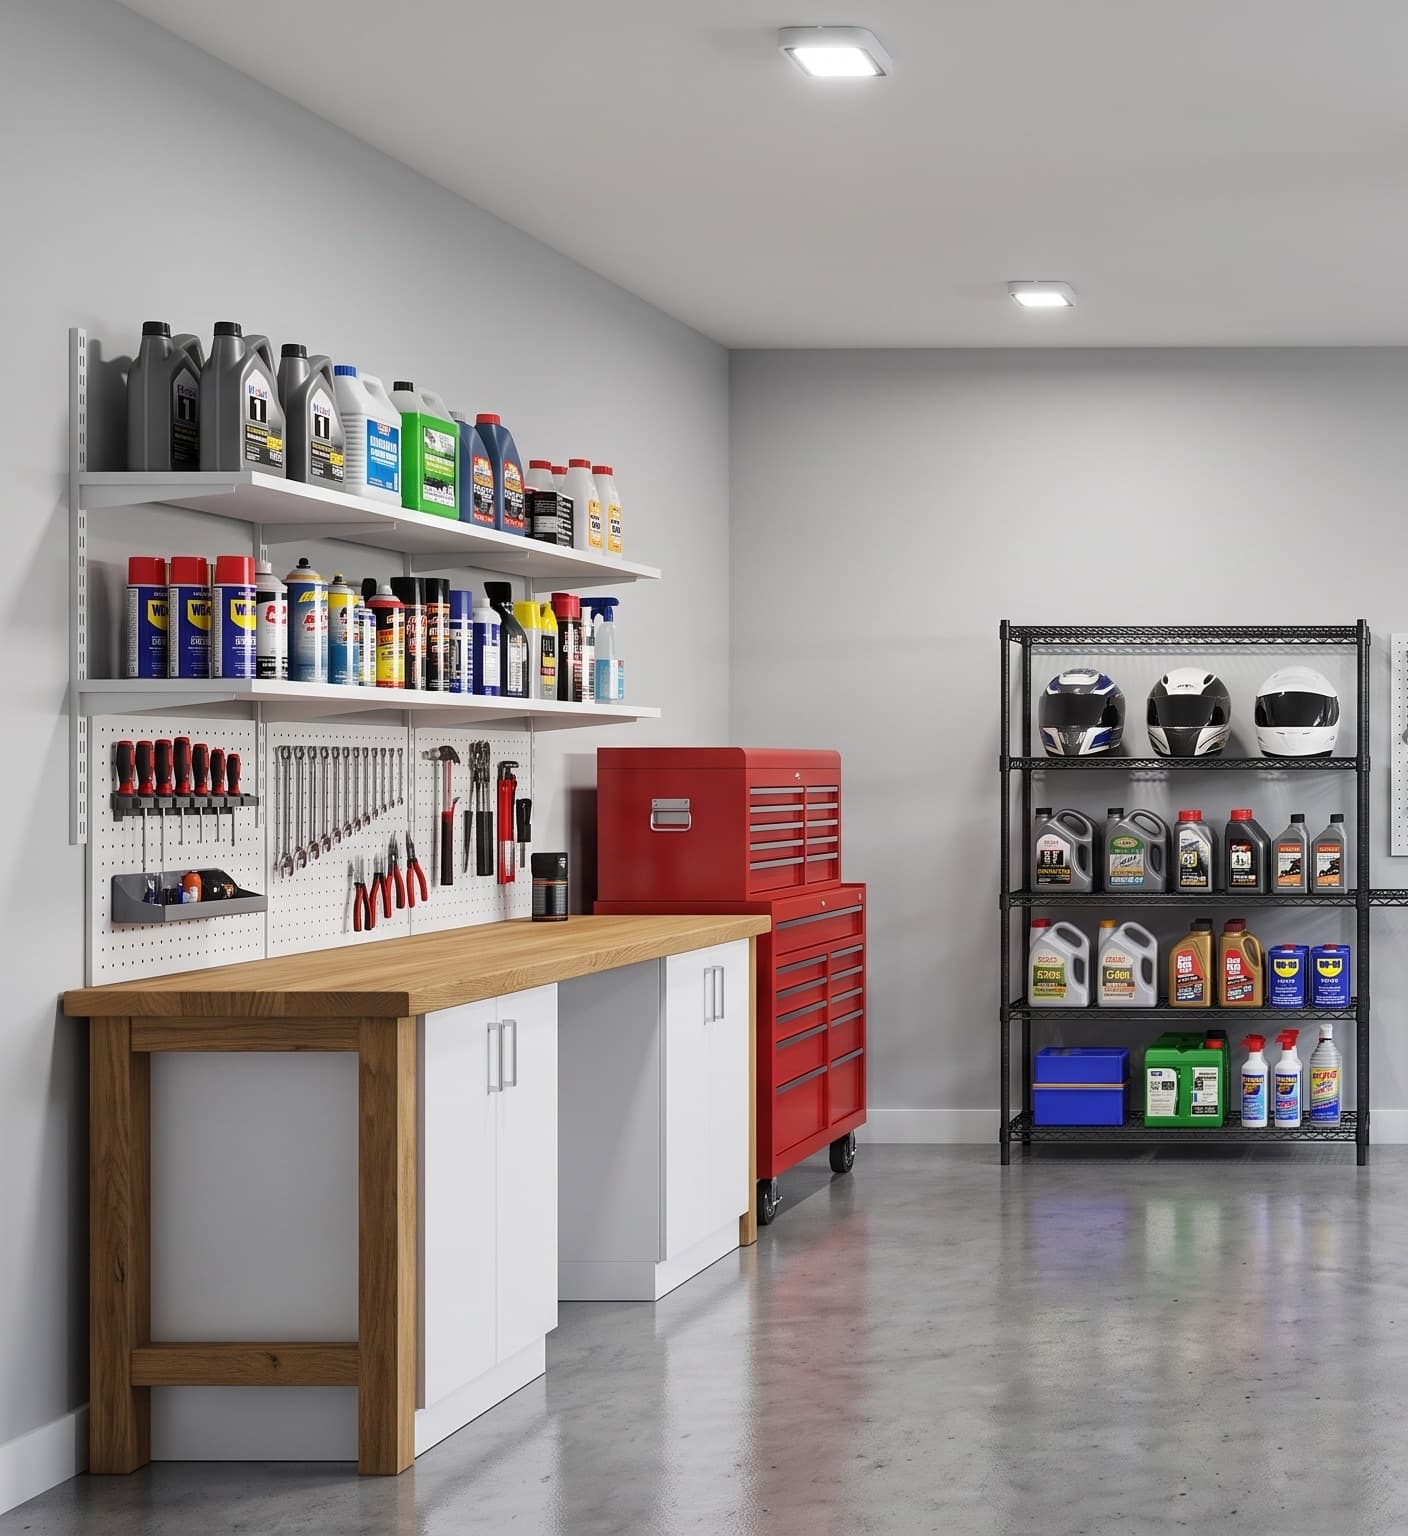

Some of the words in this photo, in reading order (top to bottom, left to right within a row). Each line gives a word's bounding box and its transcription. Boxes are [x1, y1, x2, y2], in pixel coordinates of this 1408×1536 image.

[183, 399, 190, 420] 1
[254, 399, 261, 421] 1
[318, 416, 325, 438] 1
